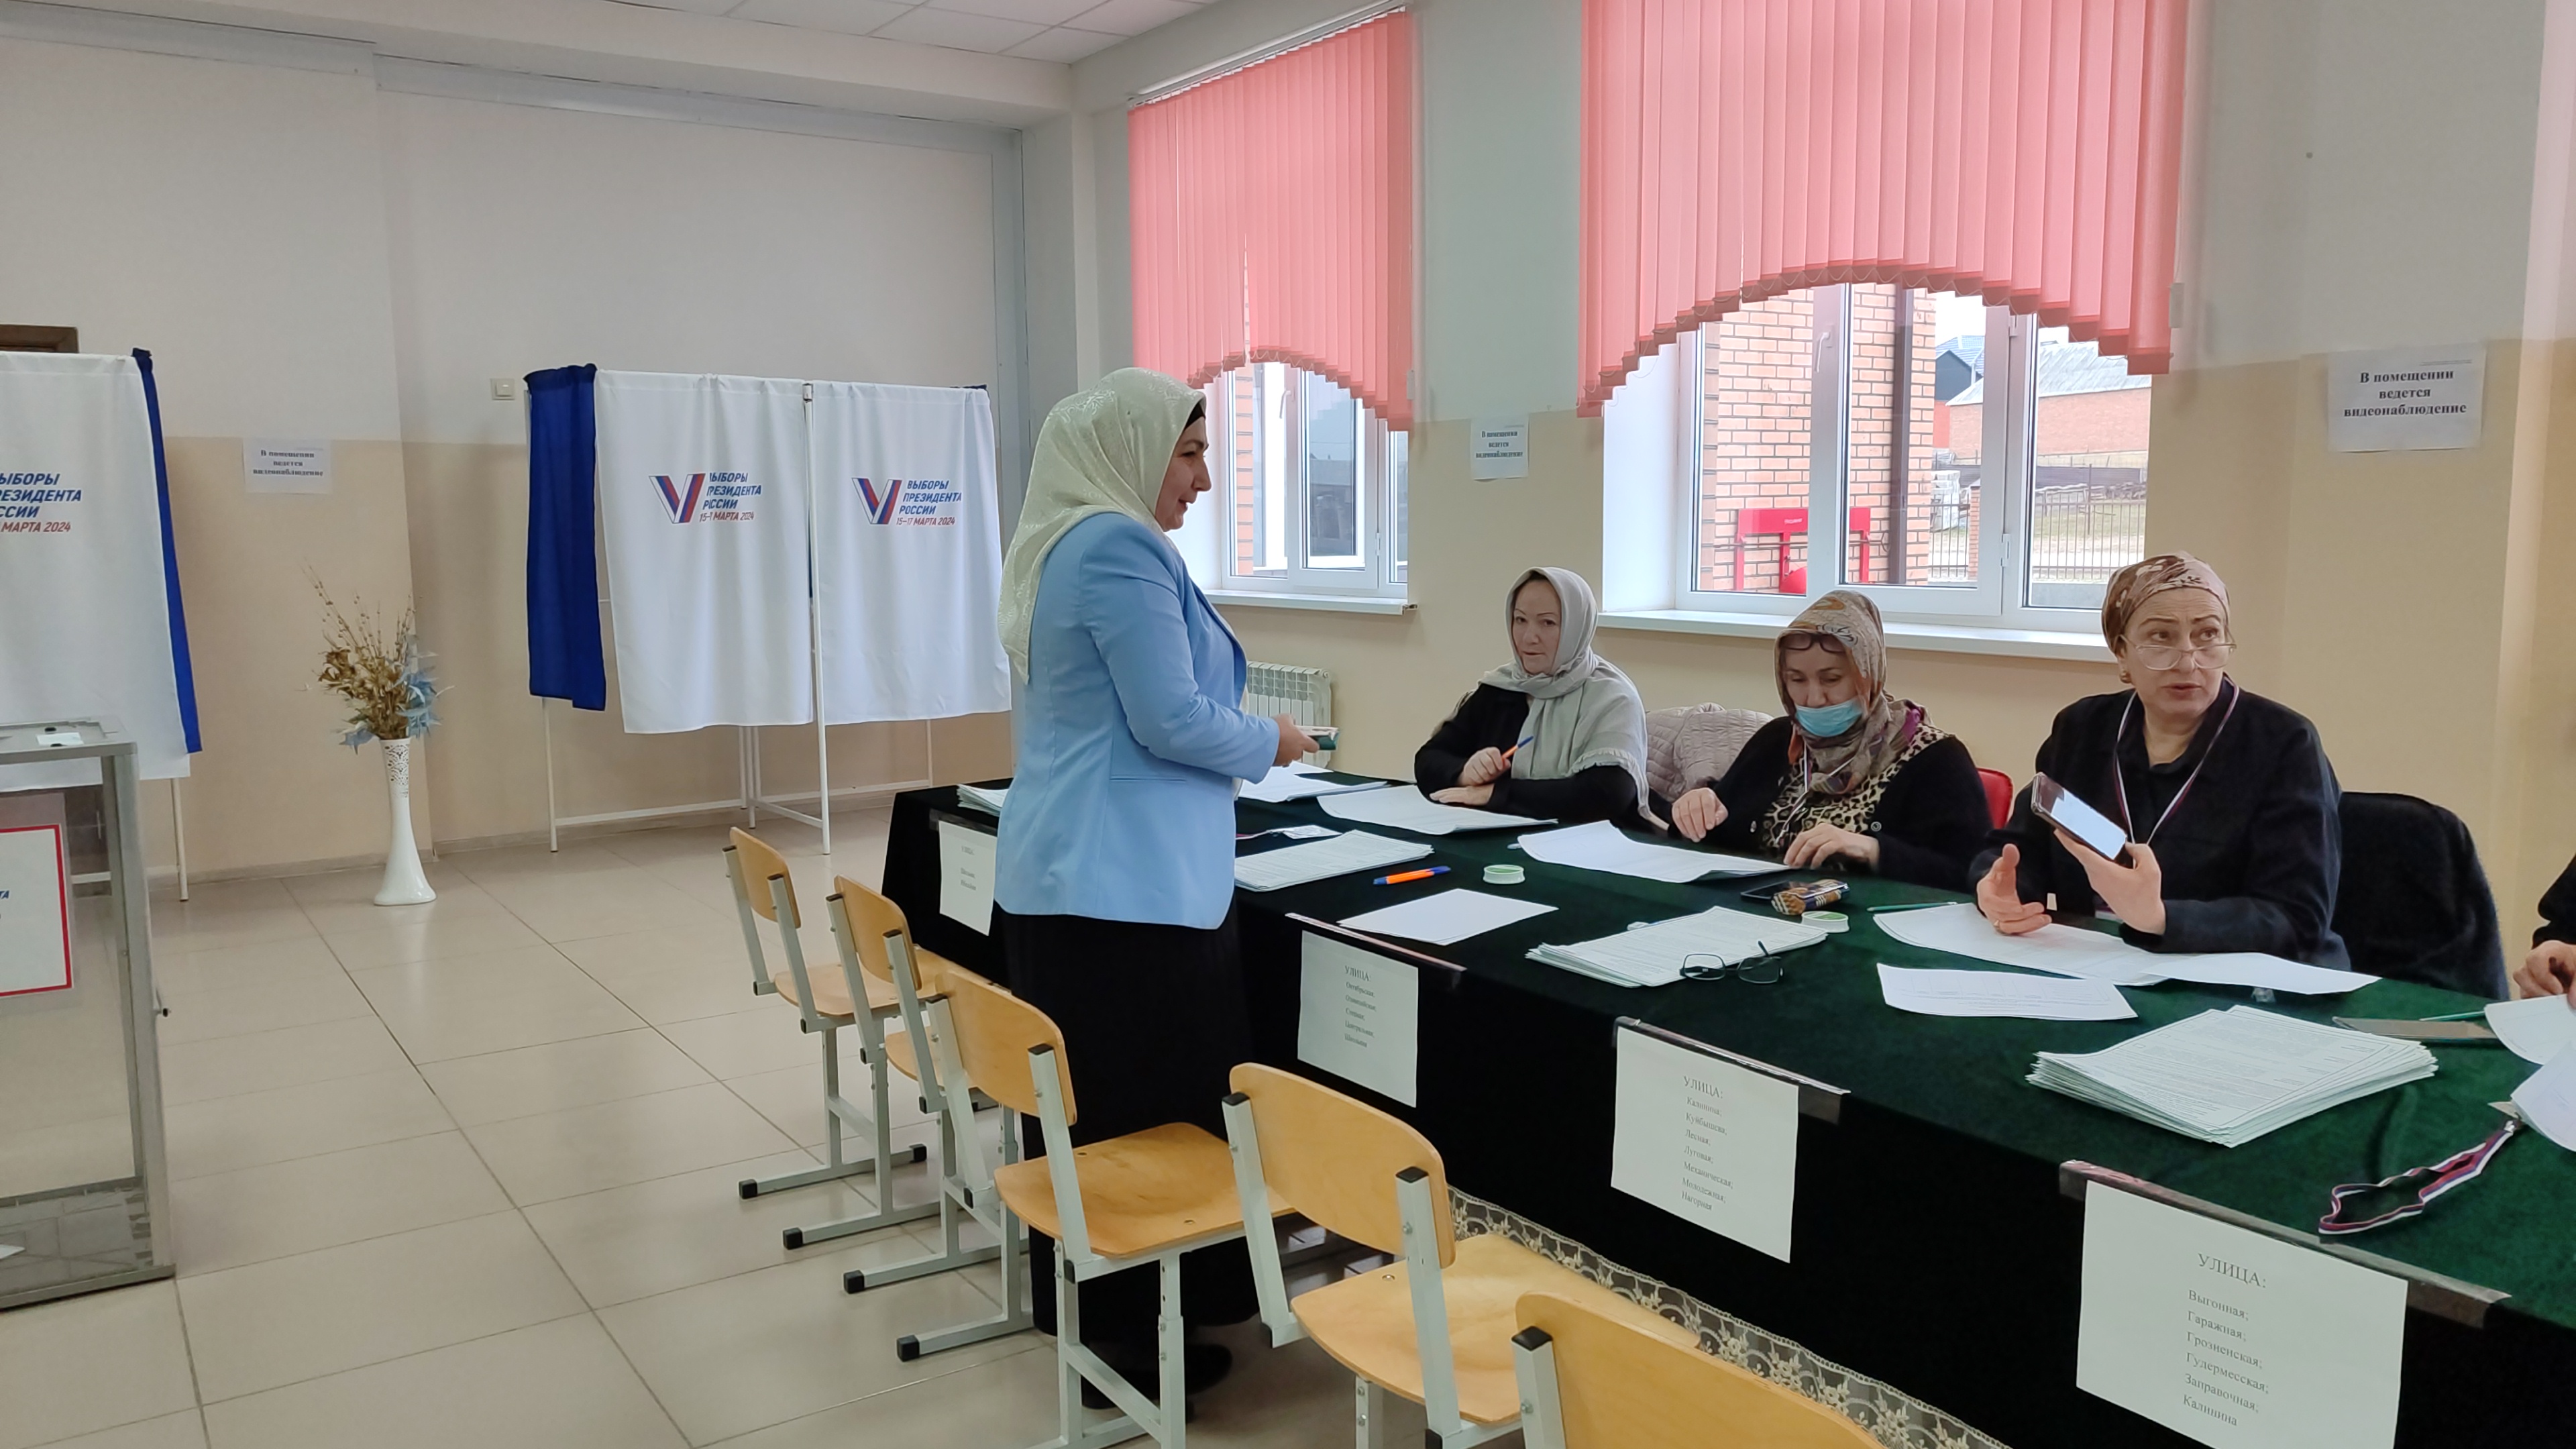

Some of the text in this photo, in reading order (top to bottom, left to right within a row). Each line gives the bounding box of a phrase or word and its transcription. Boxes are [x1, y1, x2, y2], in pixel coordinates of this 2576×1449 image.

[2360, 370, 2454, 383] В помещении
[2379, 388, 2431, 399] ведется
[2344, 404, 2467, 417] видеонаблюдение
[907, 480, 949, 490] ВЫБОРЫ
[0, 489, 82, 503] ЕЗИДЕНТА
[902, 492, 962, 503] ПРЕЗИДЕНТА
[713, 511, 739, 521] МАРТА
[899, 505, 936, 515] РОССИИ
[1, 521, 71, 533] МАРТА 2024
[913, 517, 937, 525] МАРТА
[938, 517, 955, 525] 2024
[1683, 1075, 1723, 1099] УЛИЦА:
[2198, 1252, 2266, 1288] УЛИЦА:
[2188, 1289, 2249, 1322] Выгонная;
[2188, 1310, 2247, 1342] Гаражная;
[2187, 1331, 2263, 1369] Грозненская;
[2186, 1352, 2269, 1394] Гудермесская;
[2185, 1373, 2259, 1413] Заправочная;
[2183, 1394, 2238, 1426] Калинина
